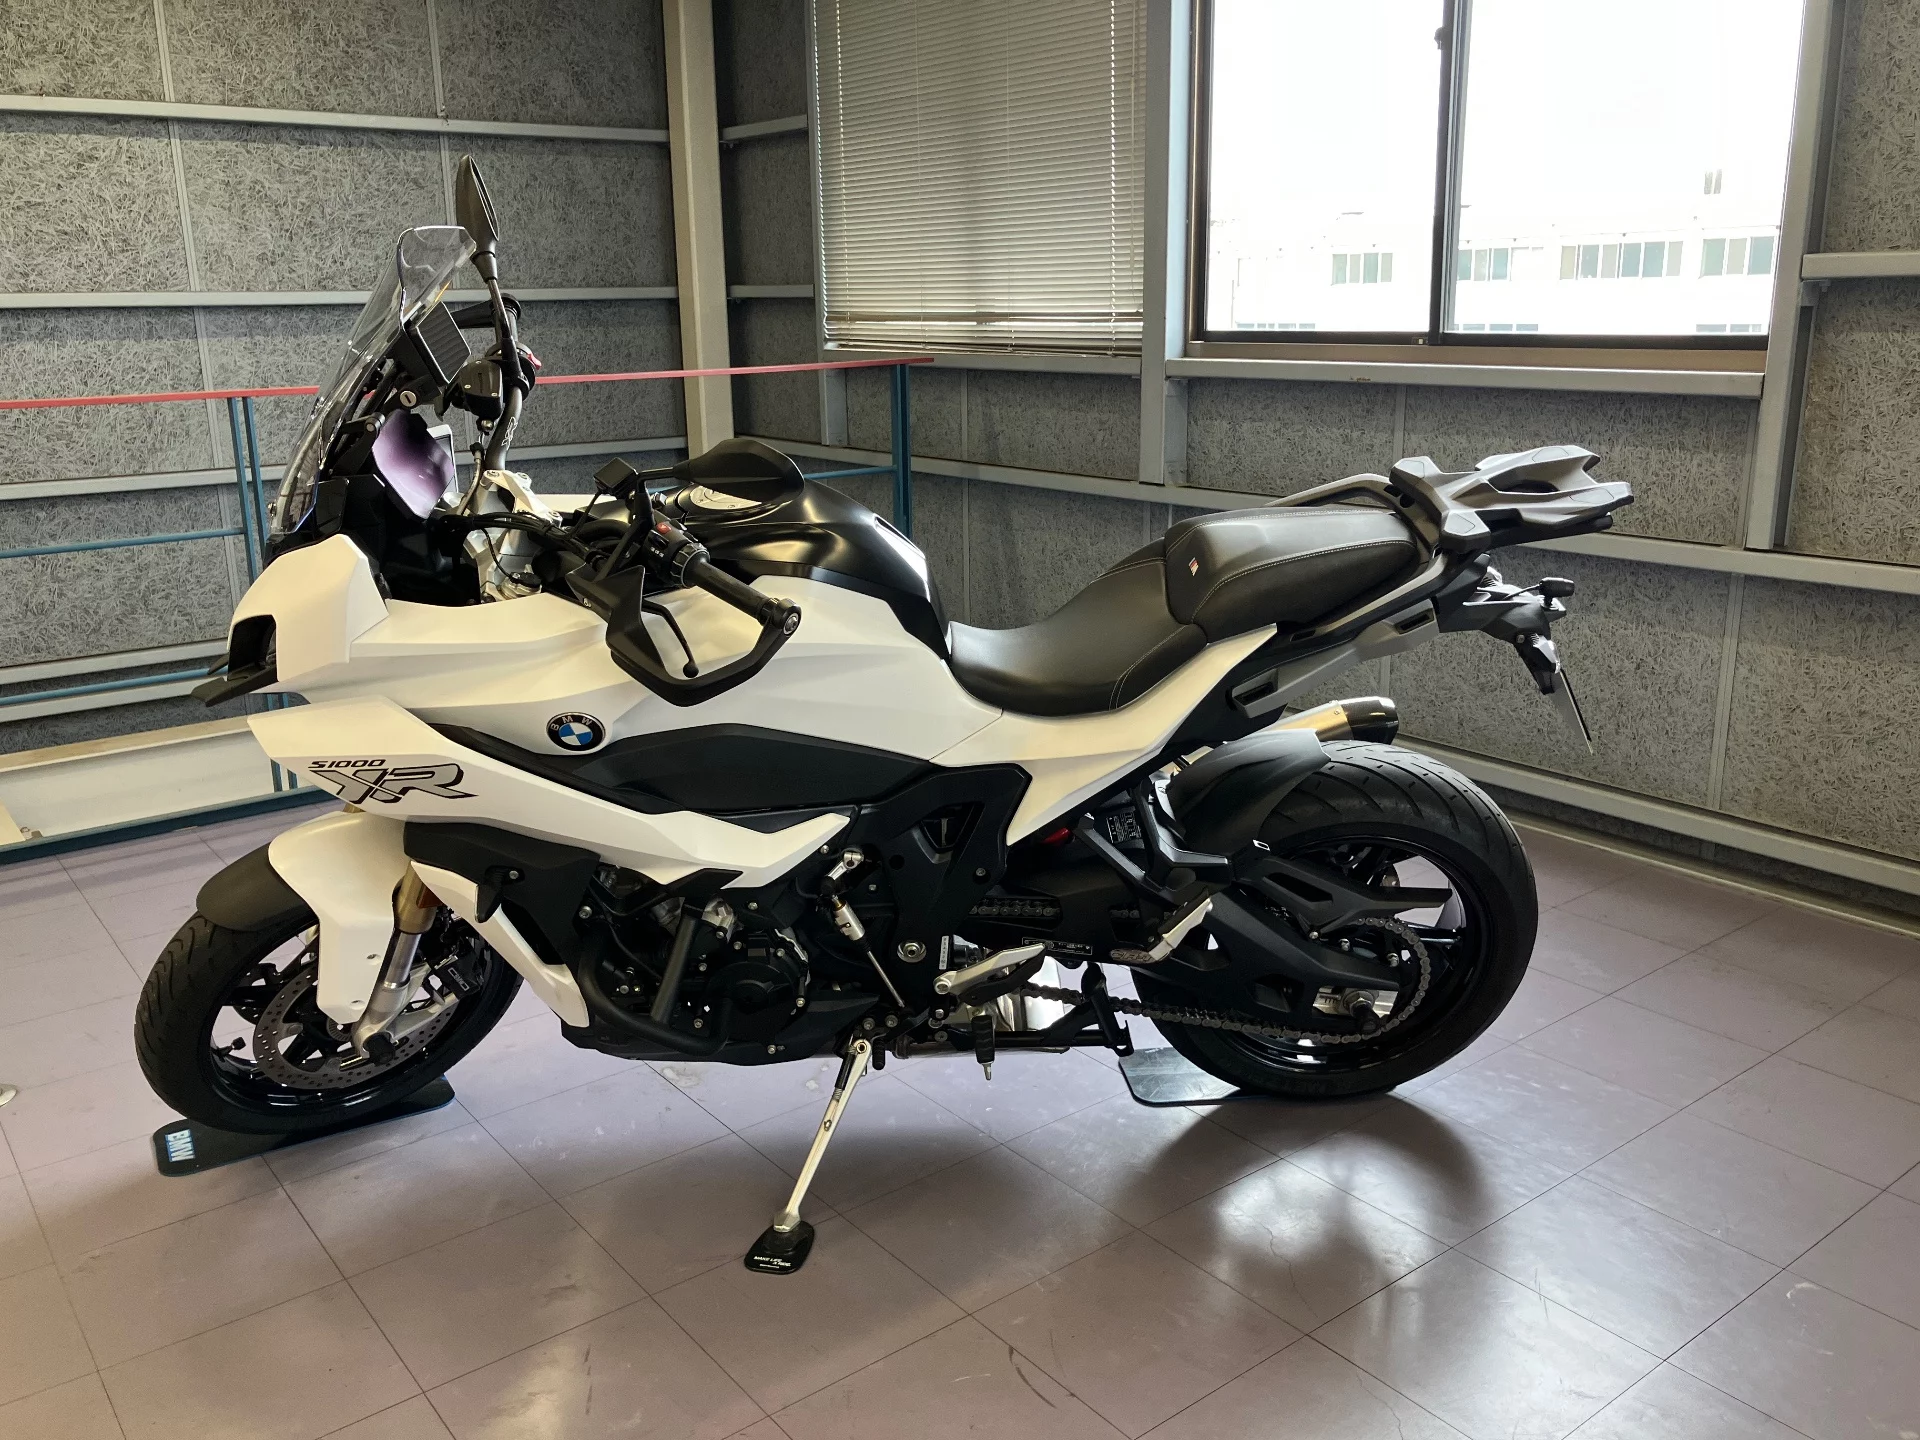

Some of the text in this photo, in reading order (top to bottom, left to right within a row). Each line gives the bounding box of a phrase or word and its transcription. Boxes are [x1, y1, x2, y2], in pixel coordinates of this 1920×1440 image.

[550, 715, 593, 731] BMW
[308, 759, 387, 769] S1000
[164, 1128, 196, 1163] BMW
